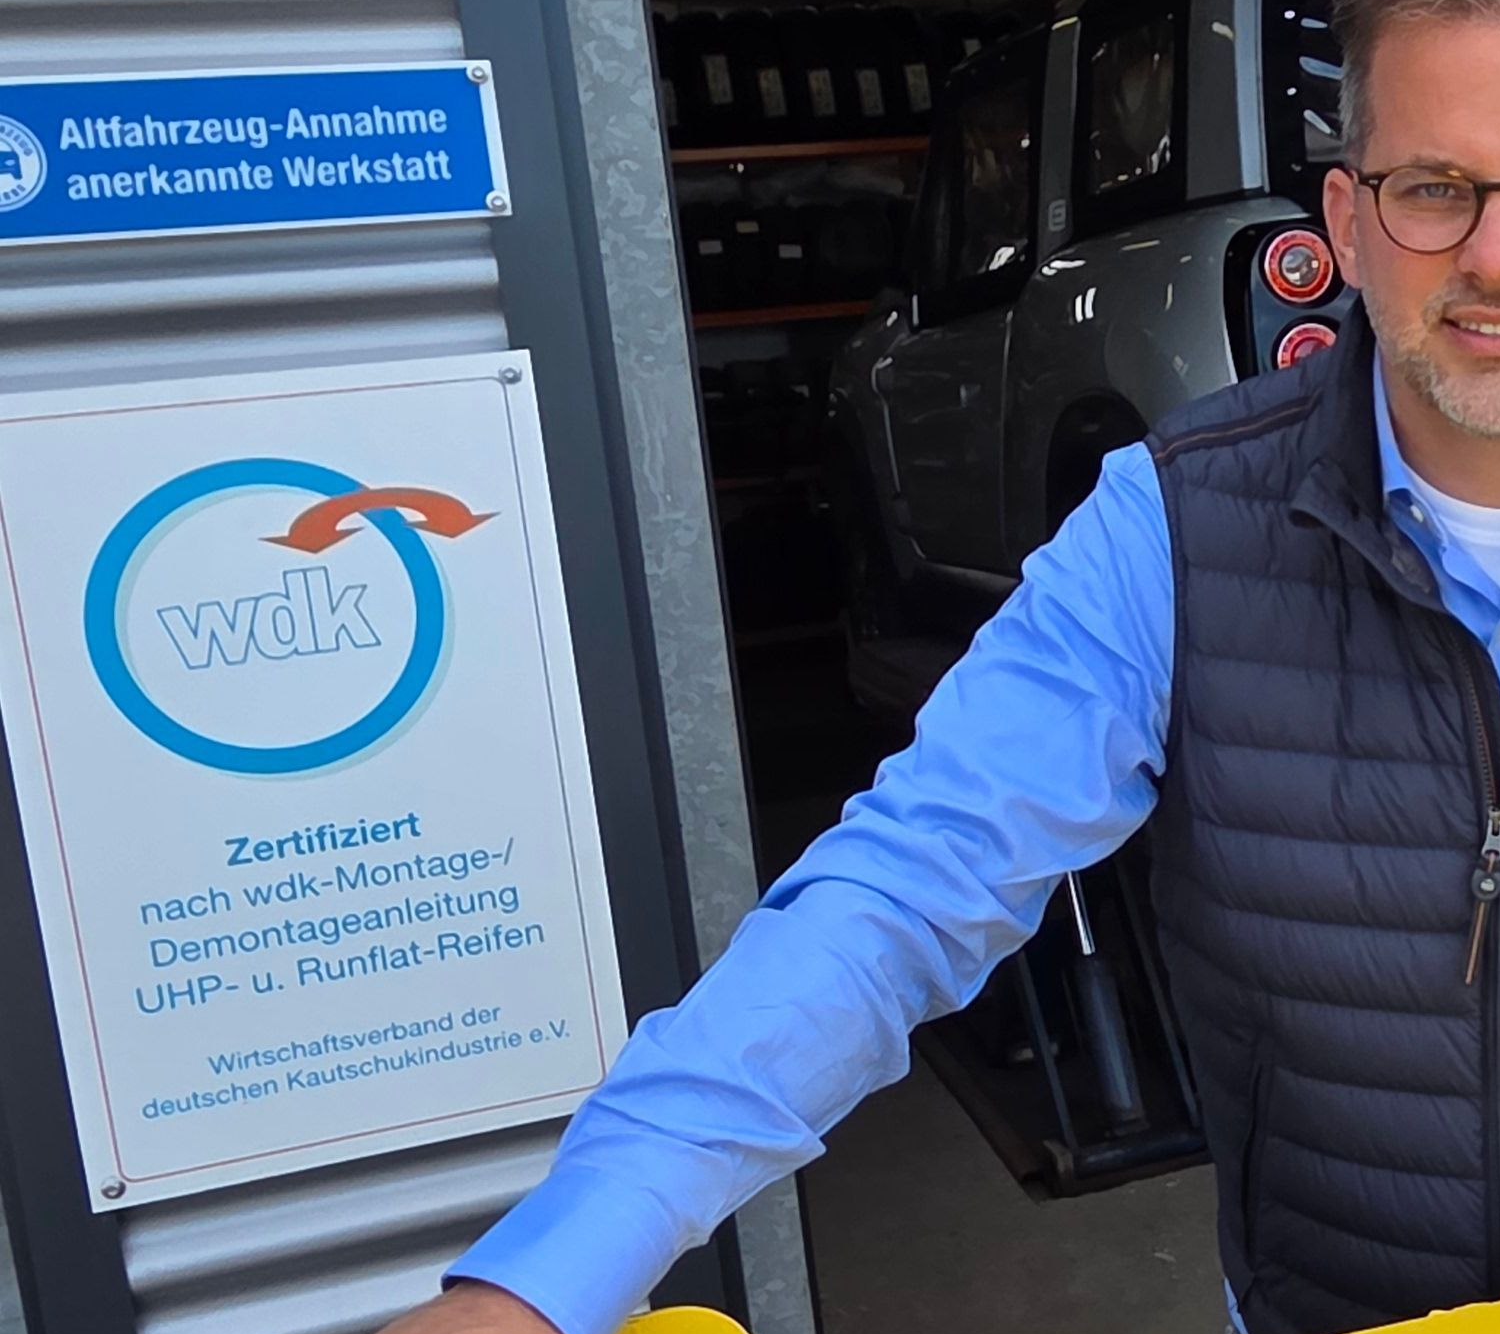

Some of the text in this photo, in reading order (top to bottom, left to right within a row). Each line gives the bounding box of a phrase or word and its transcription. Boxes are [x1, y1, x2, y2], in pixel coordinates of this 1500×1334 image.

[60, 105, 448, 150] Altfahrzeug-Annahme
[67, 160, 273, 201] anerkannte
[282, 150, 452, 187] Werkstatt
[157, 565, 382, 670] wdk
[140, 836, 514, 925] nach wdk-Montage-/
[225, 812, 421, 867] Zertifiziert
[135, 922, 545, 1014] UHP- u. Runflat-Reifen
[150, 885, 520, 968] Demontageanleitung
[142, 1019, 570, 1120] deutschen Kautschukindustrie e.V.
[208, 1006, 501, 1075] Wirtschaftsverband der
